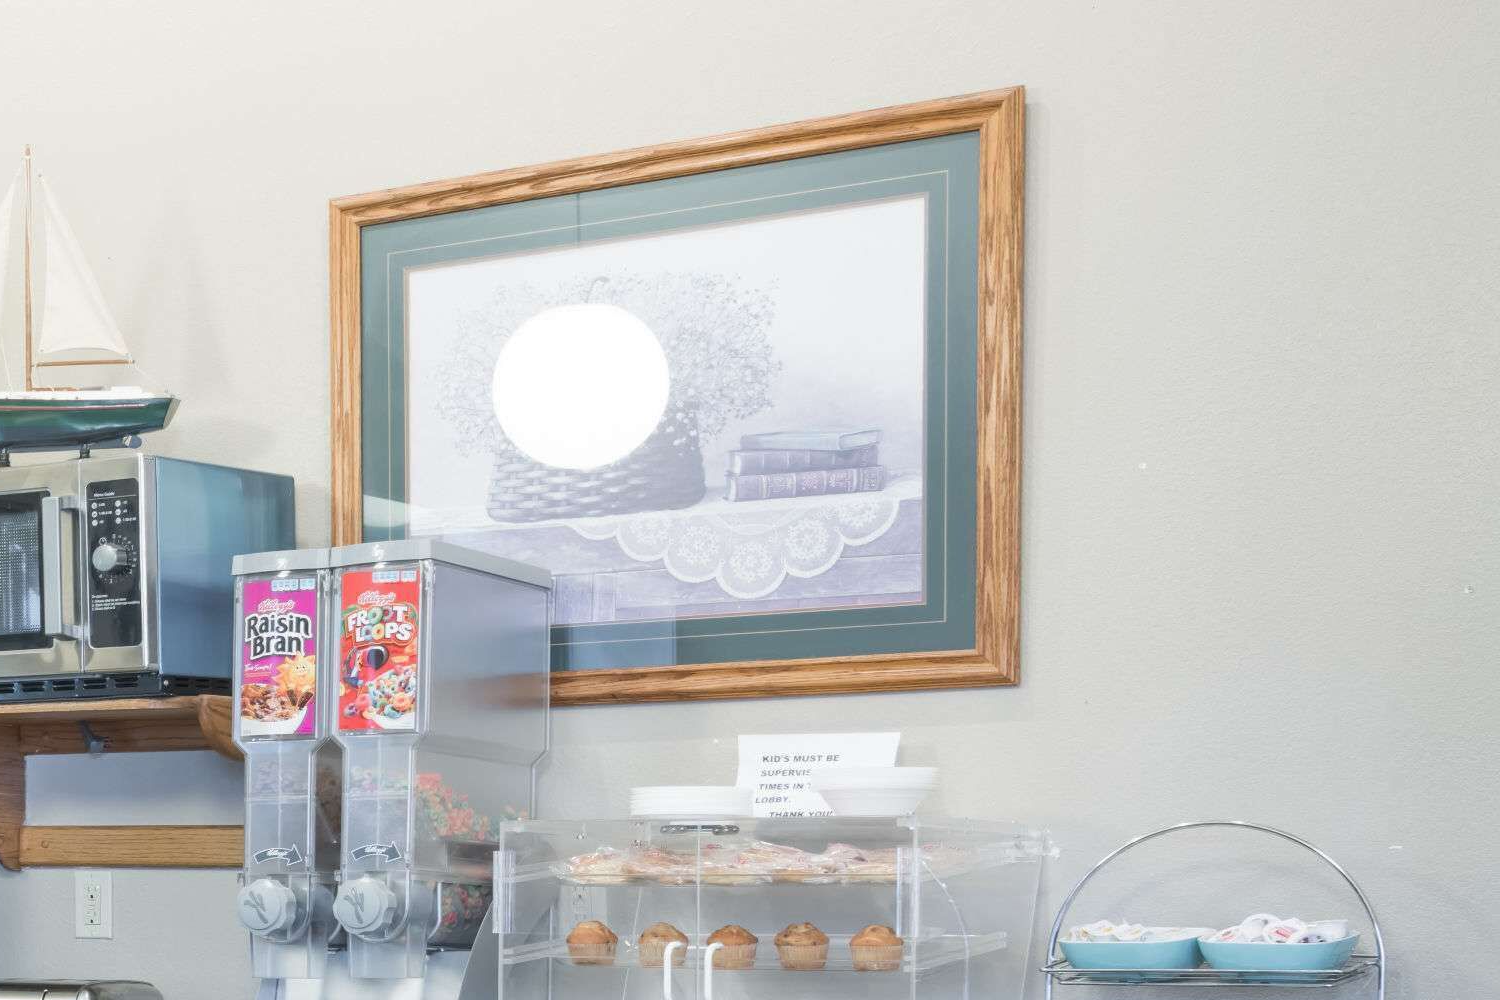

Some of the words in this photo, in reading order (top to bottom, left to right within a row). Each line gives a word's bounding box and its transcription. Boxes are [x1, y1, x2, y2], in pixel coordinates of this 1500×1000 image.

[246, 614, 310, 639] Raisin
[347, 605, 408, 632] FROOT
[355, 622, 412, 642] LOOPS
[252, 635, 302, 657] Bran
[762, 755, 790, 763] KID'S
[826, 754, 841, 762] BE
[758, 783, 790, 791] TIMES
[792, 782, 804, 790] IN
